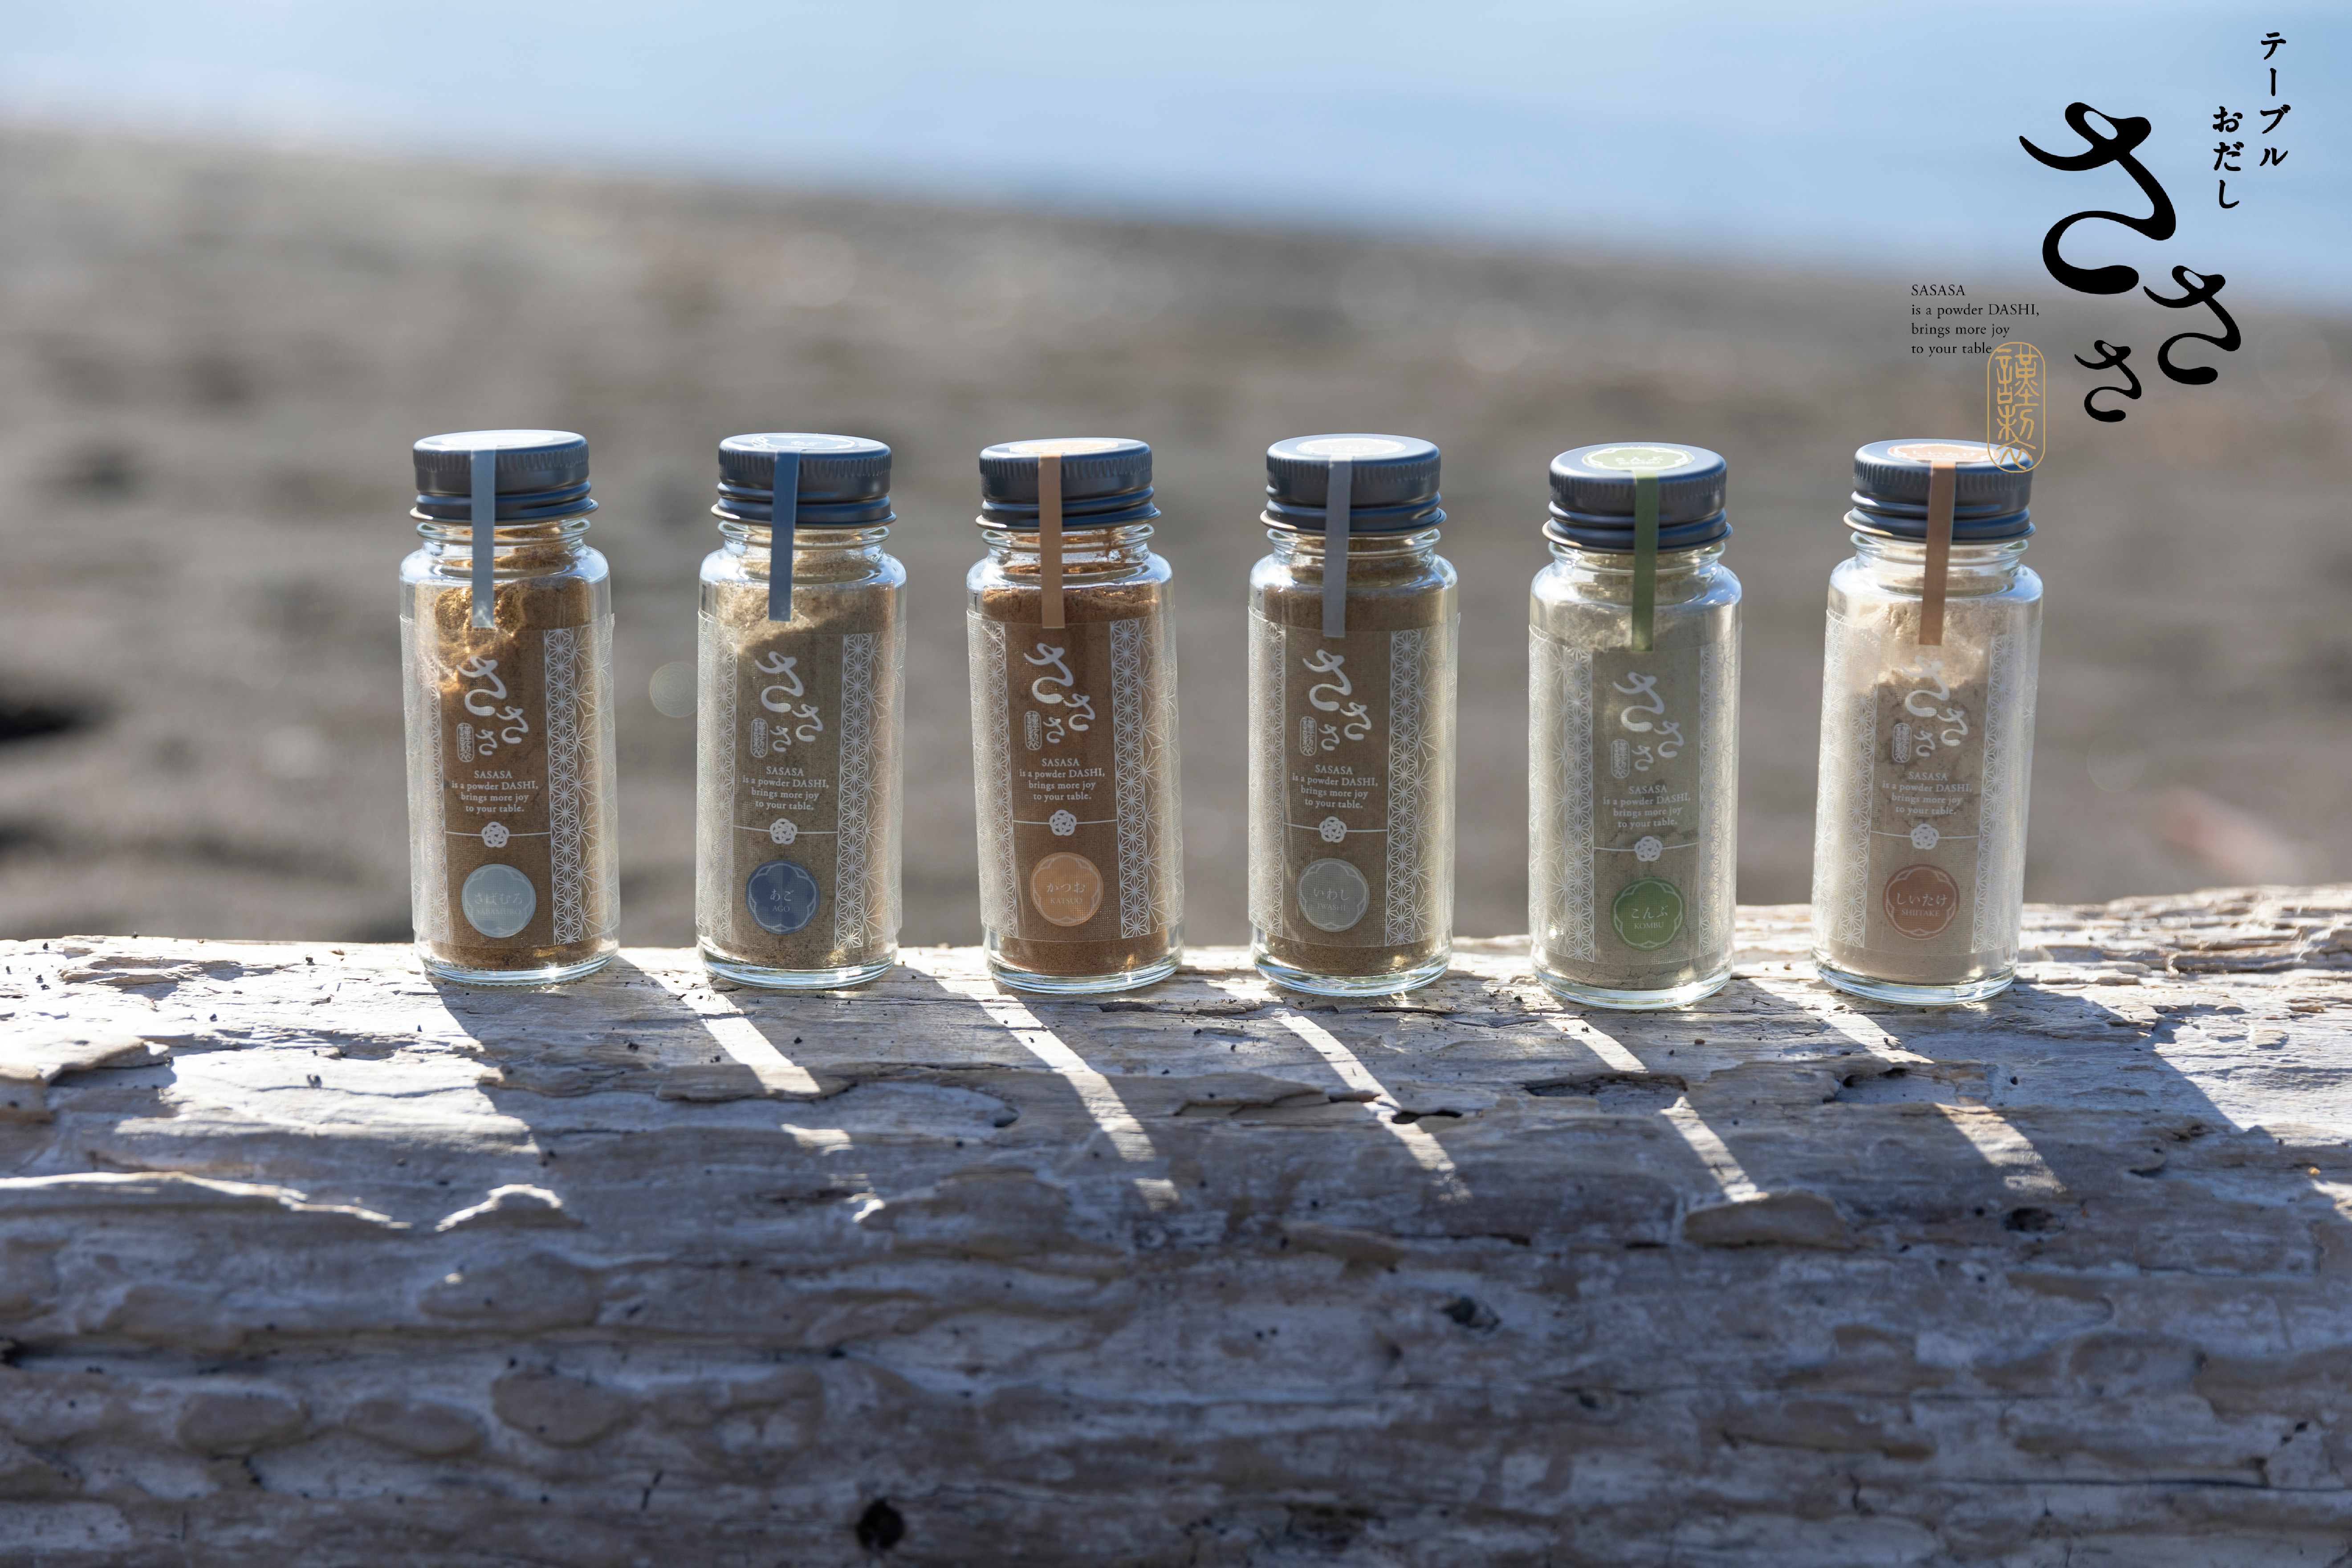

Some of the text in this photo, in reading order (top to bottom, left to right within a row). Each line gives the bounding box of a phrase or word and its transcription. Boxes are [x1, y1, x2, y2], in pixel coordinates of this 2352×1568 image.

[1042, 758, 1080, 766] SASASA
[474, 770, 513, 778] SASASA
[766, 766, 804, 776] SASASA
[1035, 770, 1066, 779] powder
[1069, 768, 1105, 777] DASHI,
[1315, 764, 1353, 774] SASASA
[743, 775, 749, 783] is
[758, 778, 789, 786] powder
[793, 779, 829, 788] DASHI,
[1292, 773, 1298, 781] is
[1307, 777, 1339, 785] powder
[1342, 778, 1378, 786] DASHI,
[1909, 771, 1948, 781] SASASA
[467, 782, 498, 791] powder
[501, 781, 538, 790] DASHI,
[1029, 780, 1054, 791] brings
[1082, 781, 1095, 790] joy
[1628, 785, 1668, 794] SASASA
[1900, 783, 1933, 792] powder
[1936, 784, 1972, 792] DASHI,
[461, 792, 487, 803] brings
[515, 794, 529, 802] joy
[751, 787, 777, 799] brings
[805, 792, 819, 801] joy
[1067, 792, 1091, 800] table.
[1301, 785, 1327, 797] brings
[1354, 790, 1368, 799] joy
[1621, 797, 1654, 807] powder
[1656, 793, 1691, 804] DASHI,
[1892, 793, 1920, 804] brings
[1948, 796, 1962, 805] joy
[477, 806, 496, 814] your
[766, 802, 786, 810] your
[789, 802, 814, 810] table.
[1932, 806, 1956, 815] table.
[1613, 808, 1641, 818] brings
[1669, 807, 1682, 816] joy
[1630, 822, 1651, 830] your
[1653, 817, 1677, 826] table.
[1047, 882, 1085, 893] かつお
[770, 889, 794, 901] あご
[1314, 888, 1349, 900] いわし
[1897, 893, 1948, 906] しいたけ
[1632, 905, 1668, 919] こんぶ
